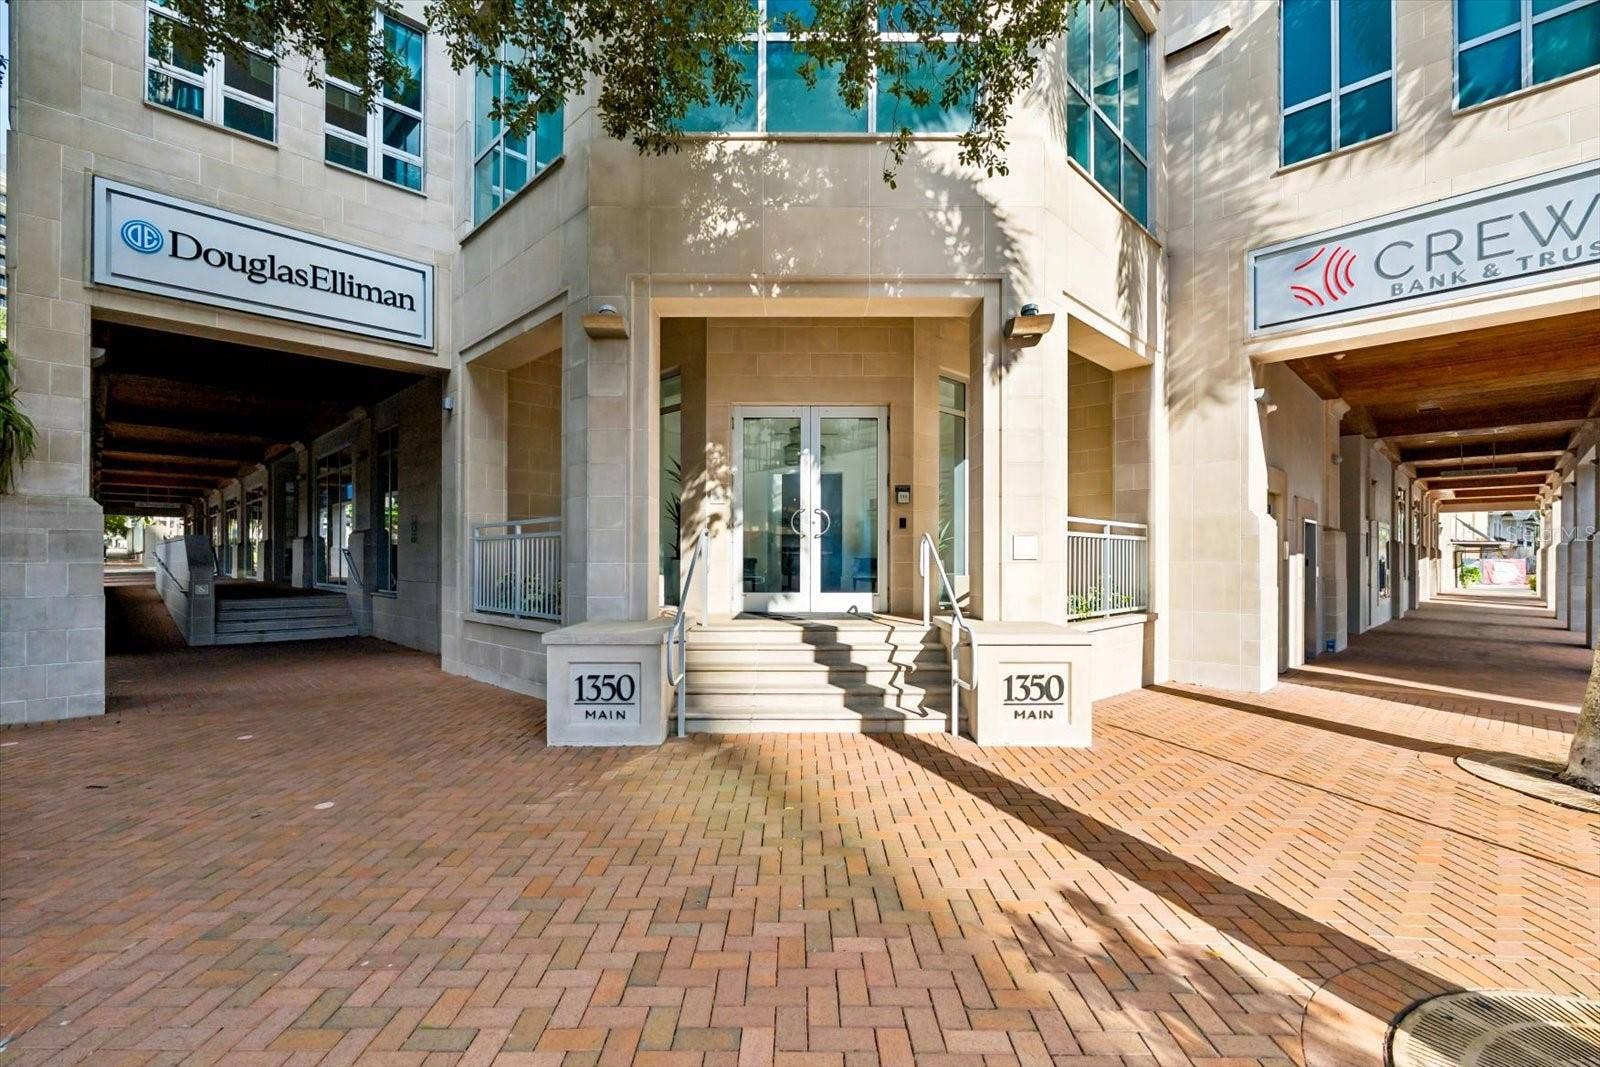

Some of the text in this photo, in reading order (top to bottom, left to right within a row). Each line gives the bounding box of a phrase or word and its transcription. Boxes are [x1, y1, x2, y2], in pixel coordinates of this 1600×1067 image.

[1374, 193, 1600, 280] CREW
[1390, 269, 1467, 296] BANK
[1482, 262, 1501, 278] &
[574, 674, 635, 702] 1350
[1003, 674, 1065, 702] 1350
[585, 710, 626, 720] MAIN
[1014, 710, 1054, 720] MAIN
